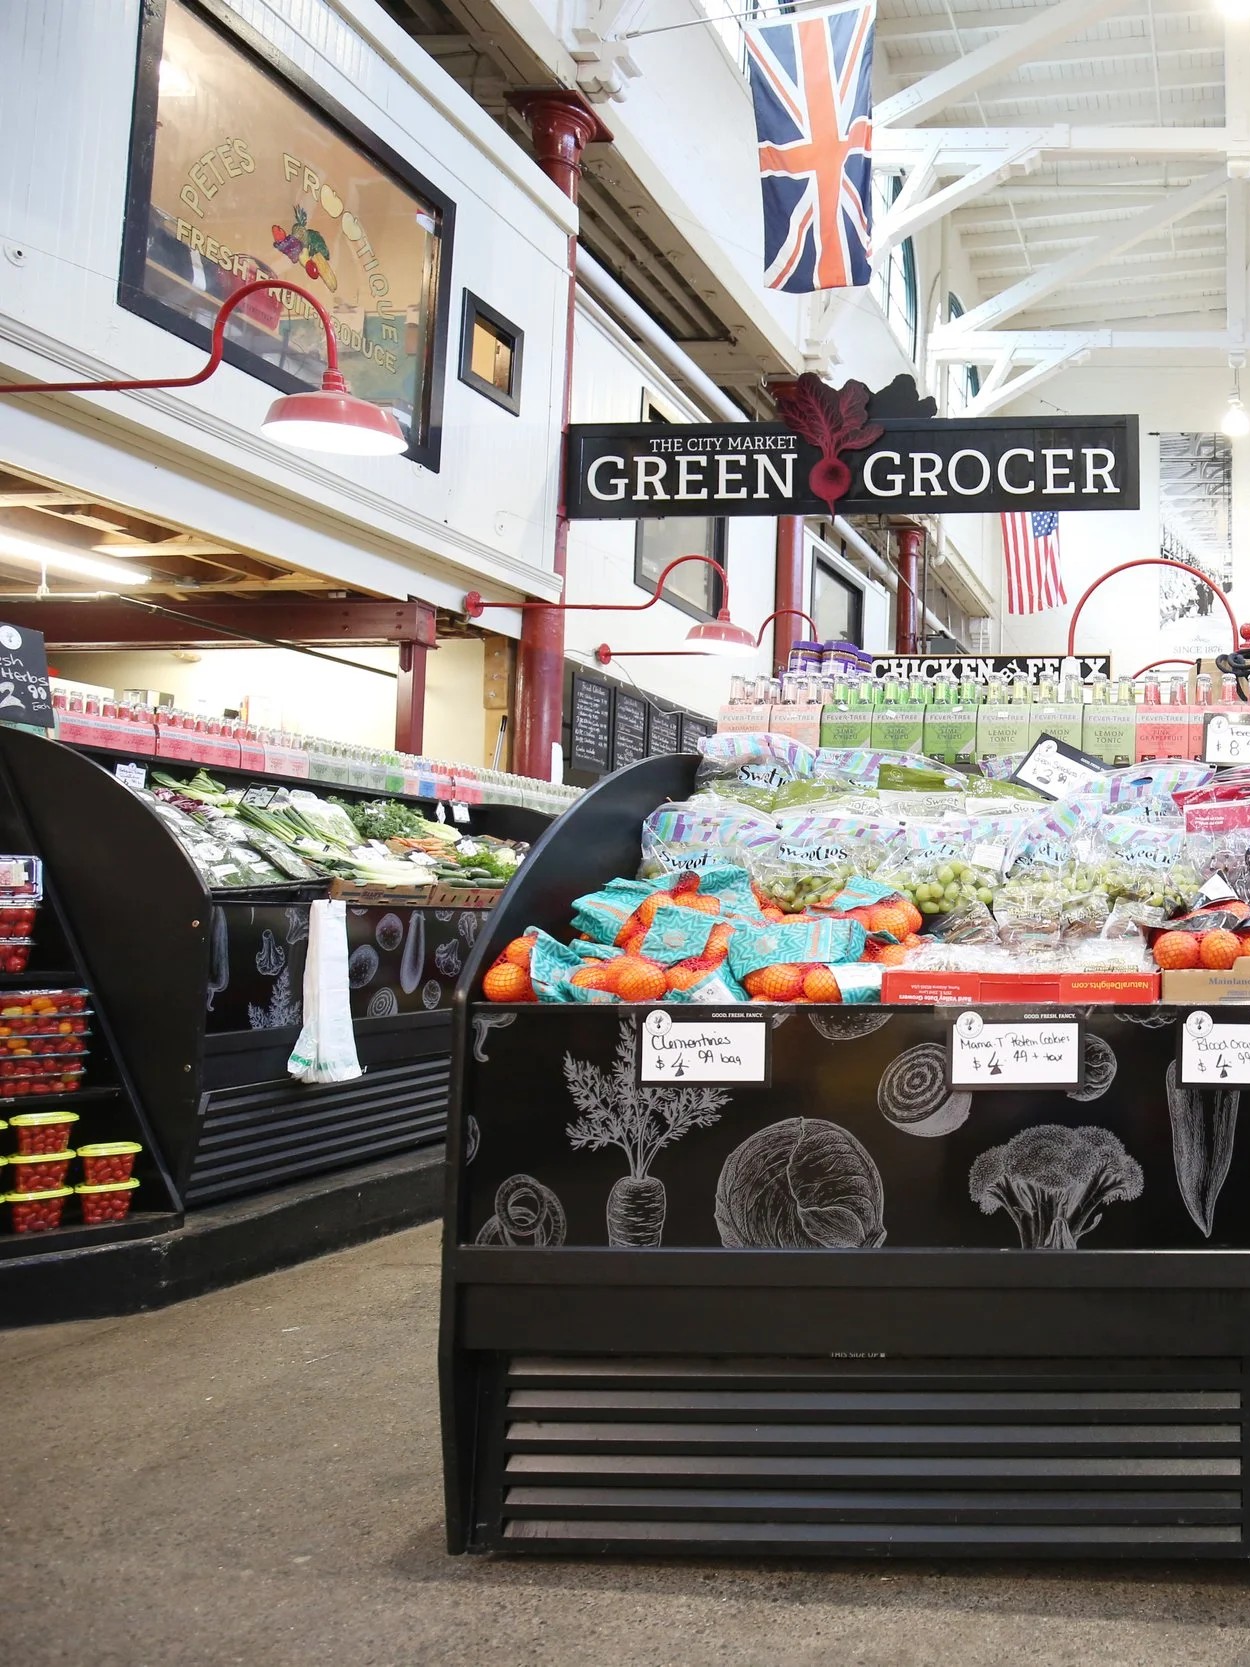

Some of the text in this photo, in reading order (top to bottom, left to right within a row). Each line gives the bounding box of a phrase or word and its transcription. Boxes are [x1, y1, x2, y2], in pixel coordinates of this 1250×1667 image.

[180, 137, 256, 218] PETE'S
[176, 217, 250, 281] FRESH
[320, 314, 397, 375] RODUCE
[650, 436, 797, 452] THE CITY MARKET
[587, 448, 1121, 501] GREEN GROCER
[1173, 646, 1202, 654] SINCE
[1, 667, 49, 687] Herbs
[872, 658, 995, 685] CHICKEN
[1001, 659, 1021, 683] BY
[988, 729, 1017, 737] LEMON
[1072, 981, 1149, 990] NaturalDelights.com
[651, 1031, 731, 1050] Clementines
[1192, 1036, 1229, 1051] Blood
[720, 1052, 742, 1066] bag
[1043, 1053, 1063, 1062] tax
